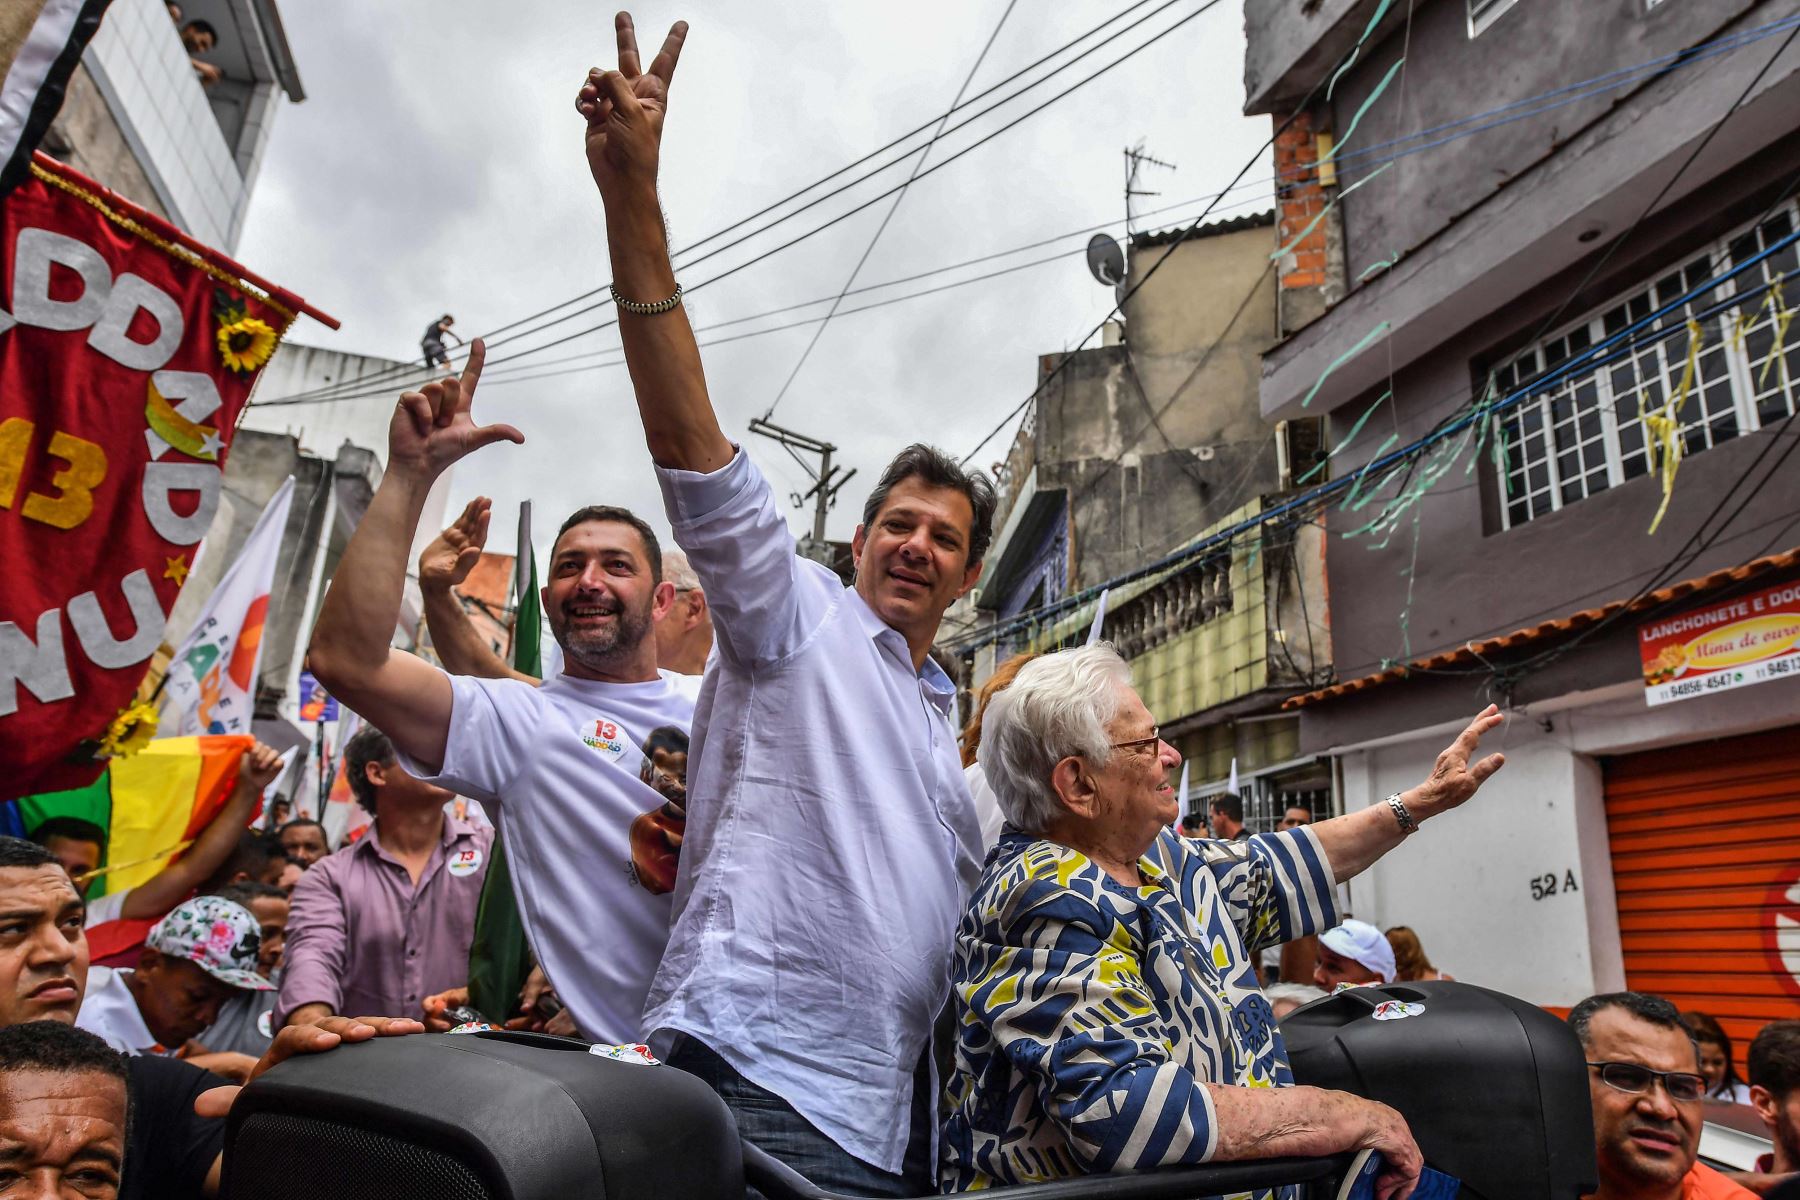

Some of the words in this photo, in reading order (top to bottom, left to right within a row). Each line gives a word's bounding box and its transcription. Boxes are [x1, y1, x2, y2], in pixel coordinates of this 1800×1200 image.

[0, 417, 108, 530] 13
[1642, 602, 1749, 642] LANCHONETE
[1753, 597, 1765, 611] E
[1693, 641, 1734, 660] Mina
[1740, 631, 1758, 648] de
[1762, 624, 1800, 643] ouro
[595, 719, 617, 739] 13
[1530, 874, 1557, 901] 52
[1562, 869, 1578, 893] A
